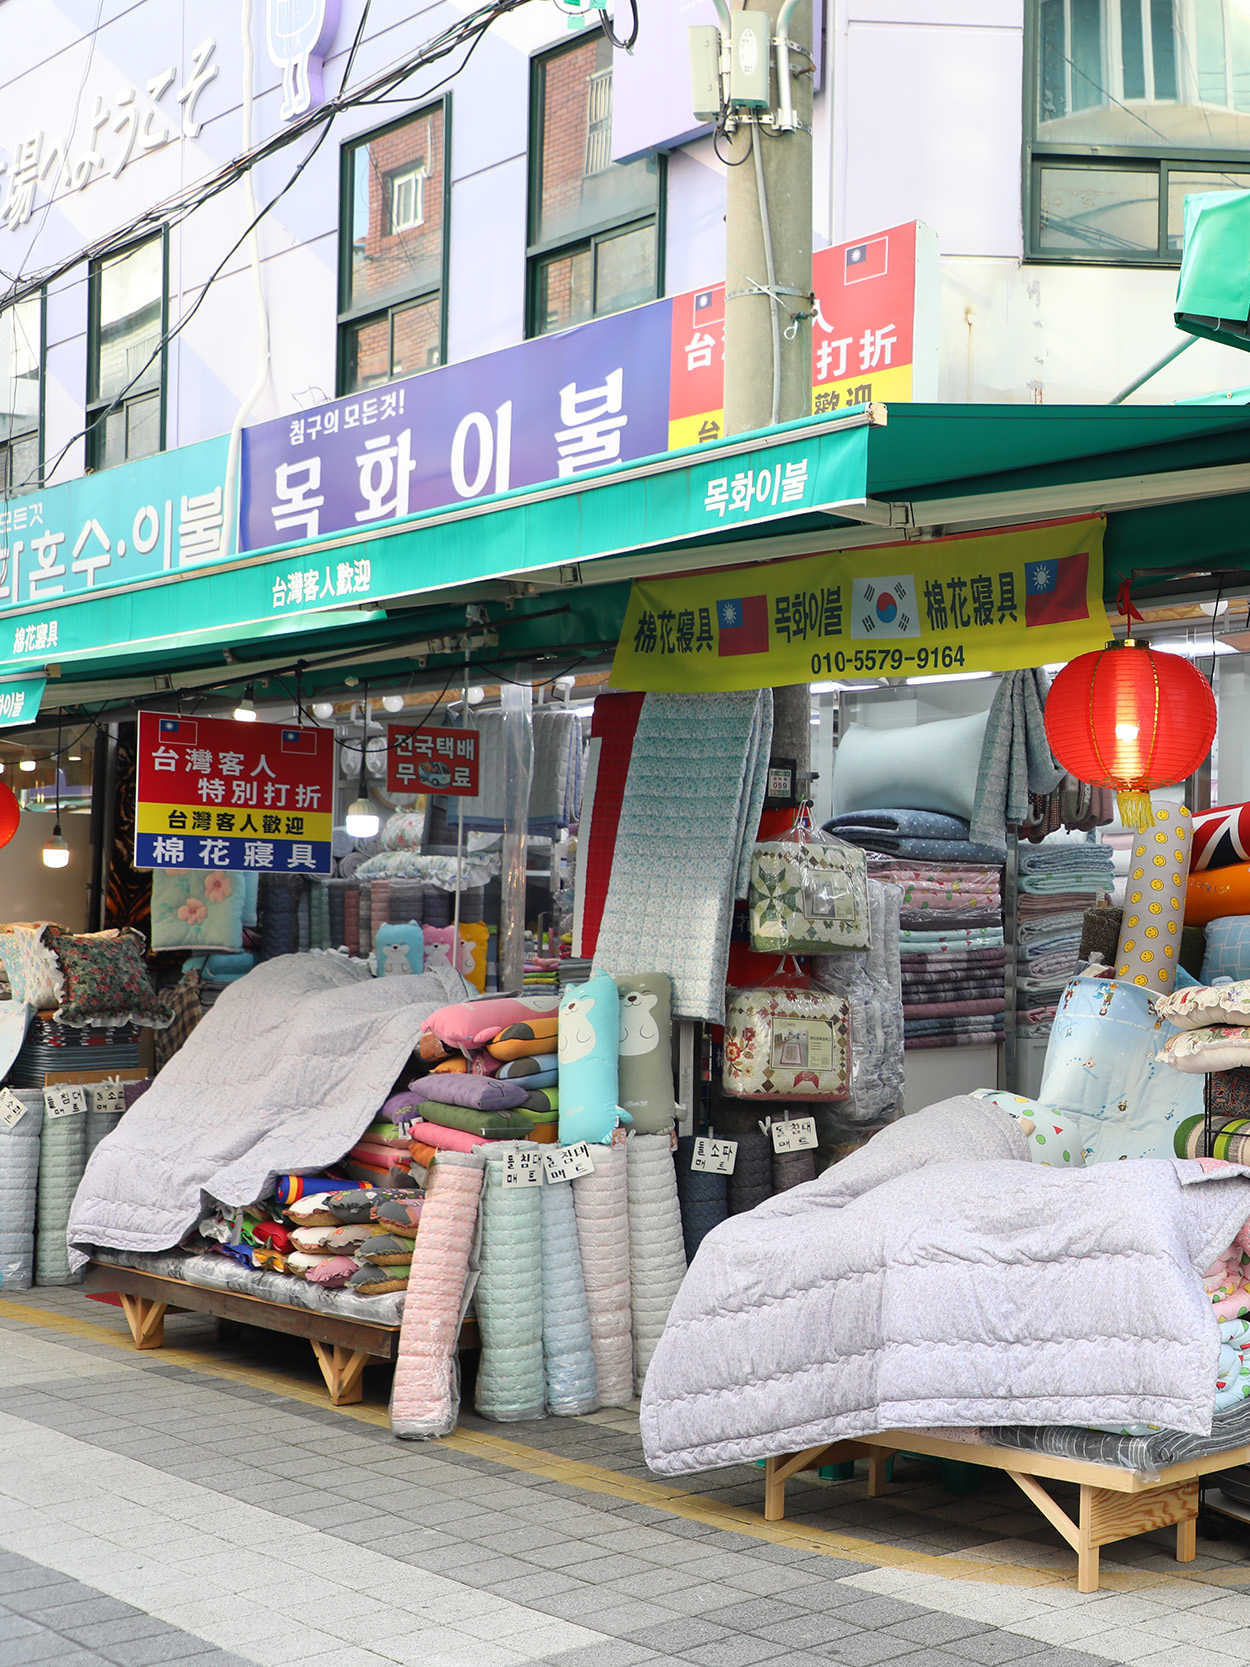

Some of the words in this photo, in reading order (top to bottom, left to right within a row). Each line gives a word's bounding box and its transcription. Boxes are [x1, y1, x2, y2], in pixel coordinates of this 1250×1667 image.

[0, 36, 219, 232] 場へようこそ
[816, 324, 897, 380] 打折
[289, 419, 340, 446] 침구의
[344, 389, 405, 431] 모든것!
[271, 367, 629, 538] 목화이불
[704, 459, 808, 517] 목화이불
[0, 502, 43, 534] 모든것
[272, 559, 371, 609] 台灣客人歡迎
[634, 607, 713, 654] 棉花寢具
[774, 586, 843, 644] 목화이불
[924, 572, 1018, 632] 棉花寢具
[13, 620, 59, 654] 棉花寢具
[811, 645, 966, 676] 010-5579-9164
[0, 691, 25, 718] 이불
[151, 746, 277, 779] 台灣客人
[394, 734, 475, 761] 전국택배
[198, 778, 322, 809] 特別打折
[773, 782, 787, 790] 059
[168, 810, 304, 836] 台灣客人歡迎
[152, 836, 317, 870] 棉花寢具
[776, 1120, 812, 1138] 돌침대
[778, 1137, 810, 1149] 매트
[507, 1153, 542, 1170] 돌침대
[546, 1144, 590, 1168] 돌침대
[550, 1163, 588, 1179] 매트
[506, 1170, 537, 1184] 매트
